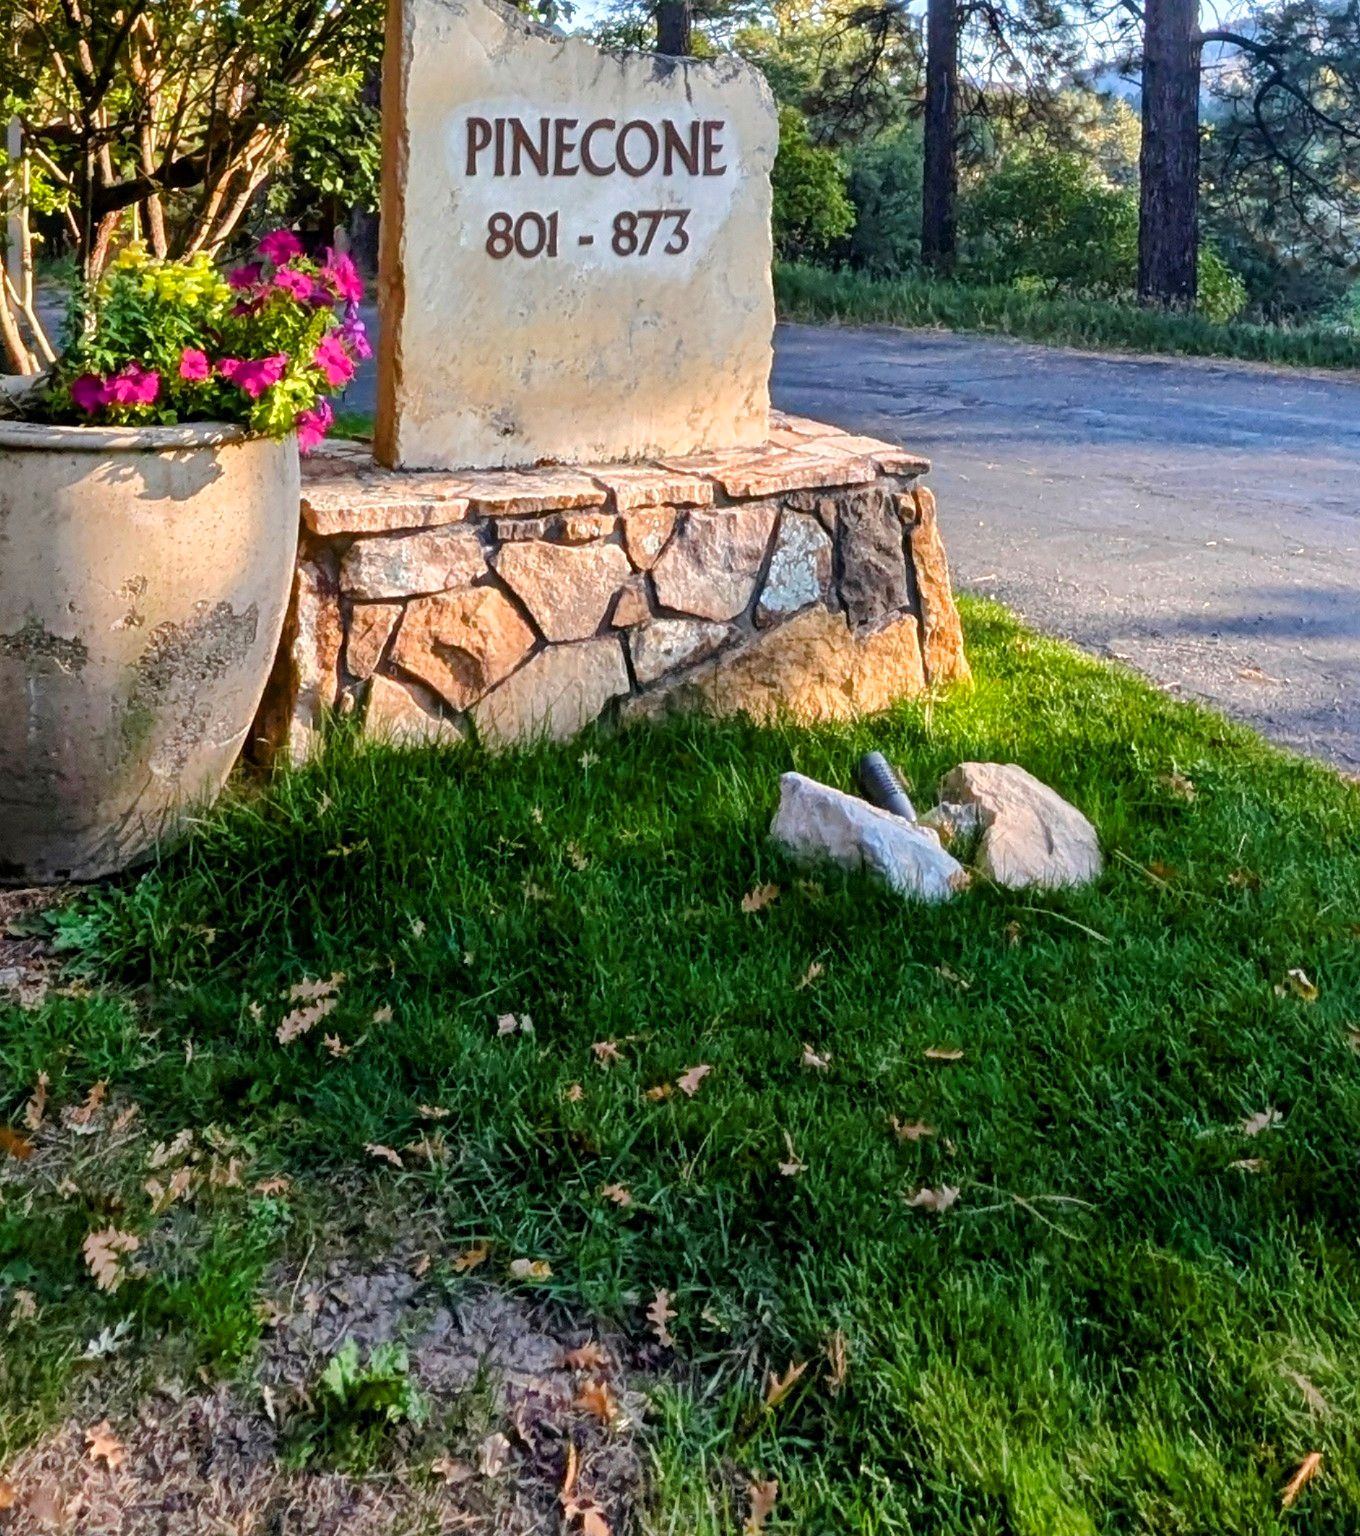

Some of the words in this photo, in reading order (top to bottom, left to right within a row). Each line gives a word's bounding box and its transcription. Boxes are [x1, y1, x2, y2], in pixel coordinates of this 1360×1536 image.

[465, 117, 727, 177] PINECONE
[485, 210, 560, 259] 801
[611, 209, 692, 258] 873
